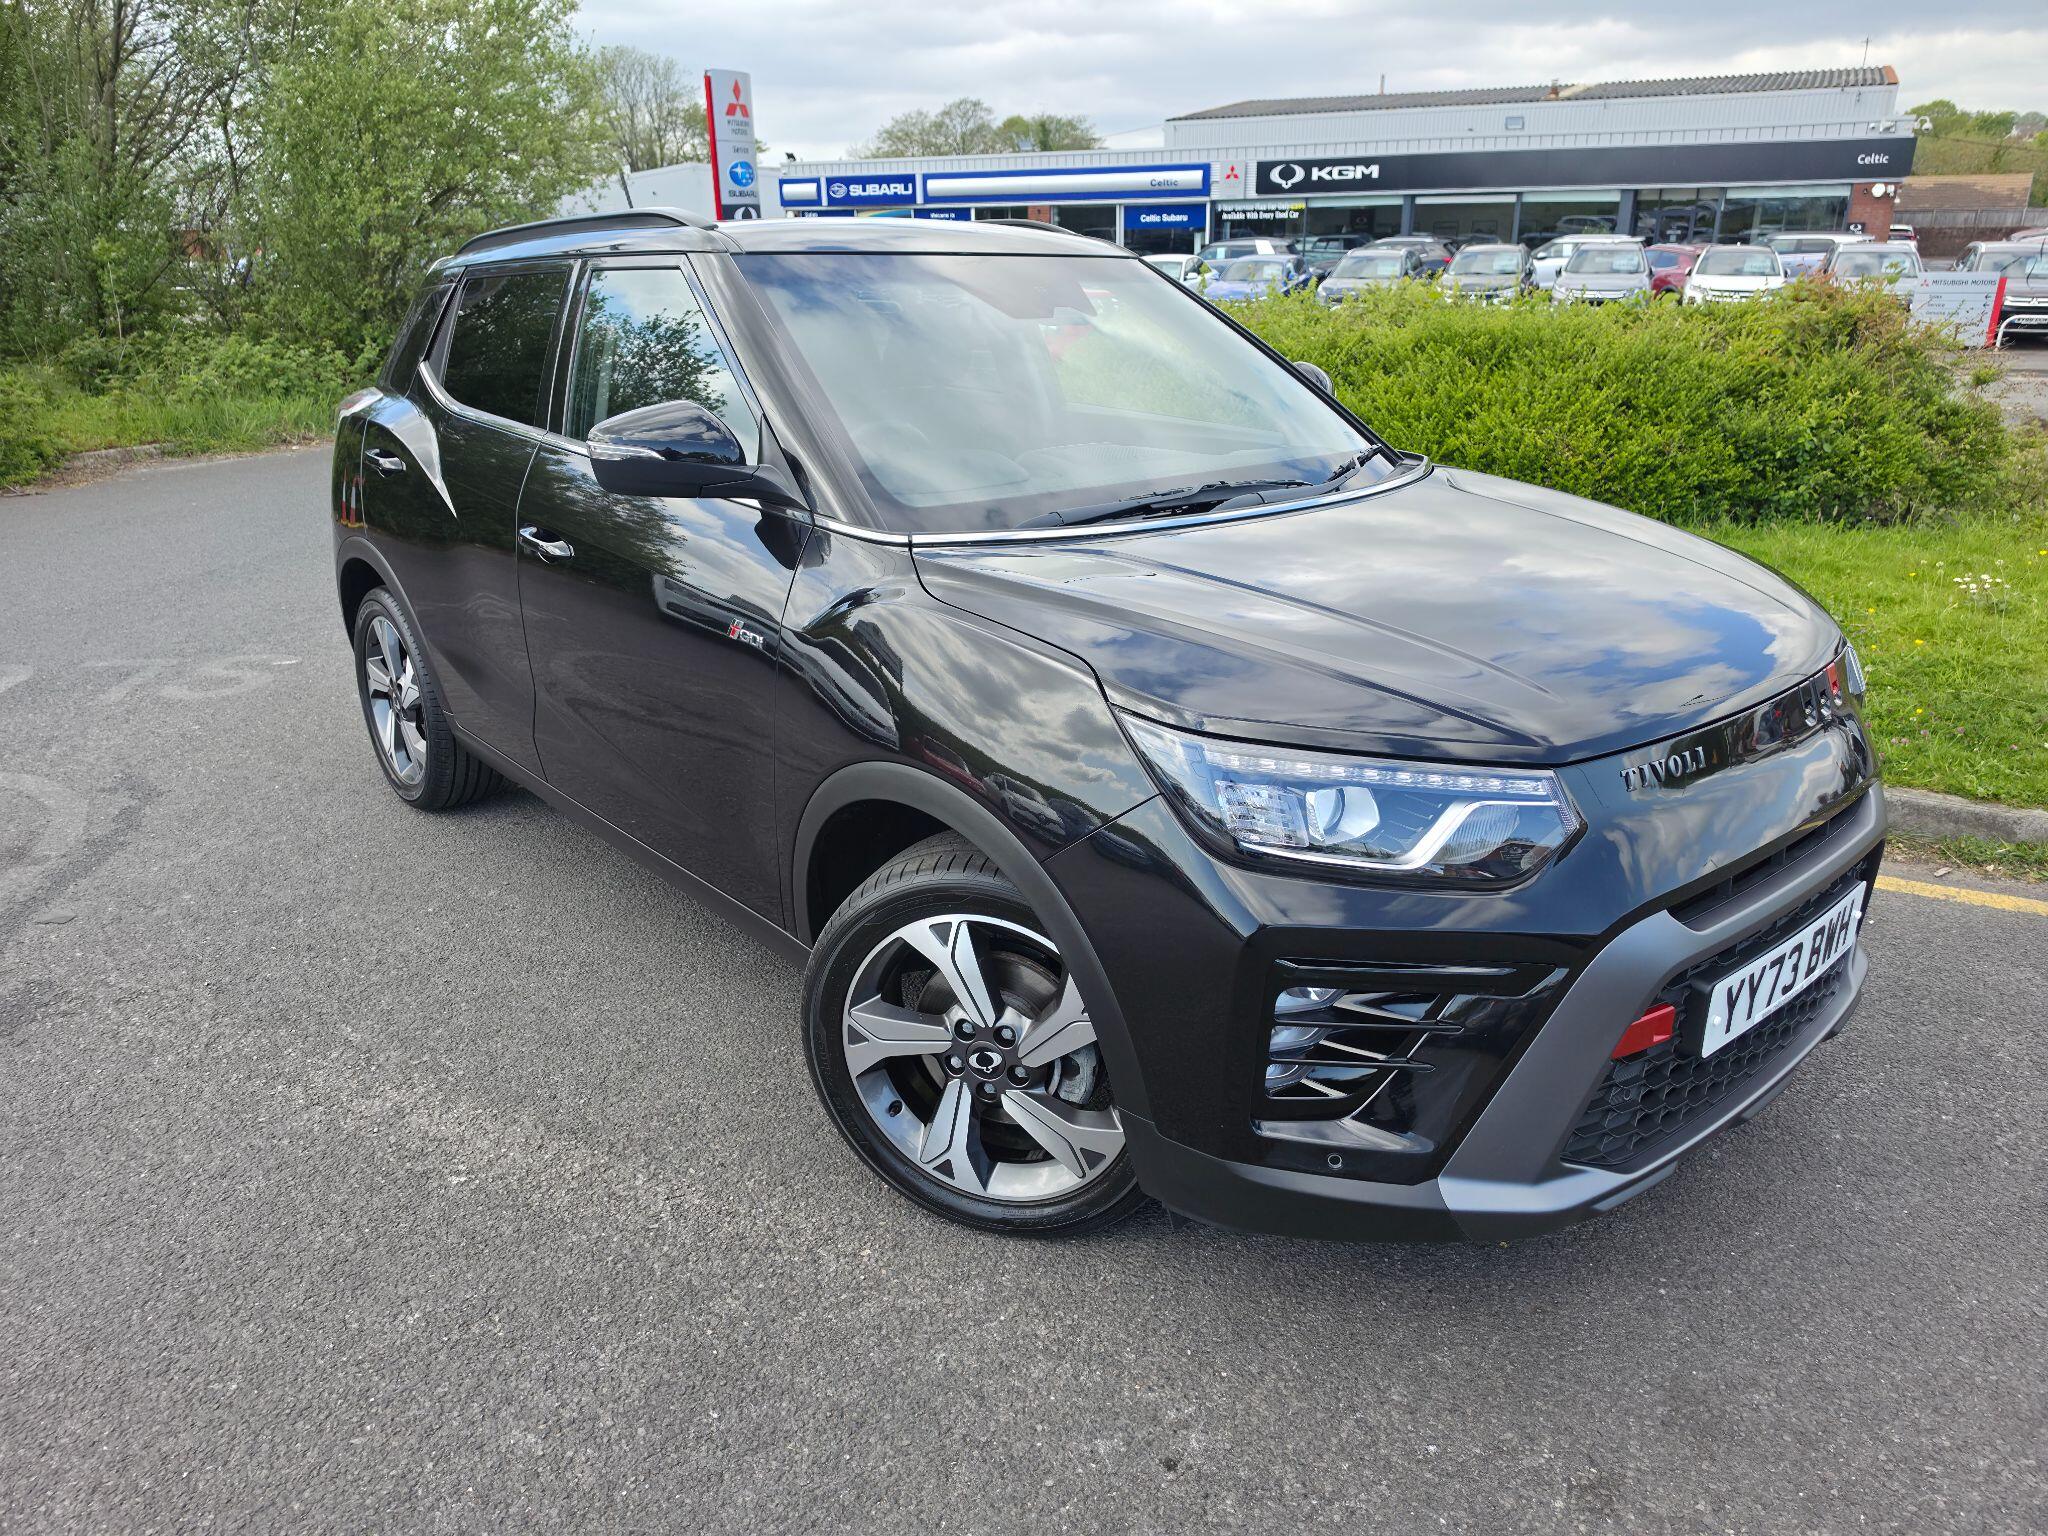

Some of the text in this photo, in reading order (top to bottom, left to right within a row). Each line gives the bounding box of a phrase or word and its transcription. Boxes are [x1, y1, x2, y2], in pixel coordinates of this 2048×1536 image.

[1857, 153, 1889, 165] Celtic
[1311, 164, 1380, 181] KGM
[1150, 178, 1179, 187] Celtic
[728, 190, 757, 198] SUBARU
[849, 183, 913, 197] SUBARU
[1140, 213, 1188, 223] Celtic Subaru
[1222, 212, 1246, 220] Available
[1259, 211, 1274, 220] Every
[1275, 210, 1288, 218] Used
[1289, 210, 1299, 218] Car
[1620, 746, 1705, 792] TIVOLI
[1725, 942, 1804, 1035] YY73
[1804, 899, 1855, 980] BWH
